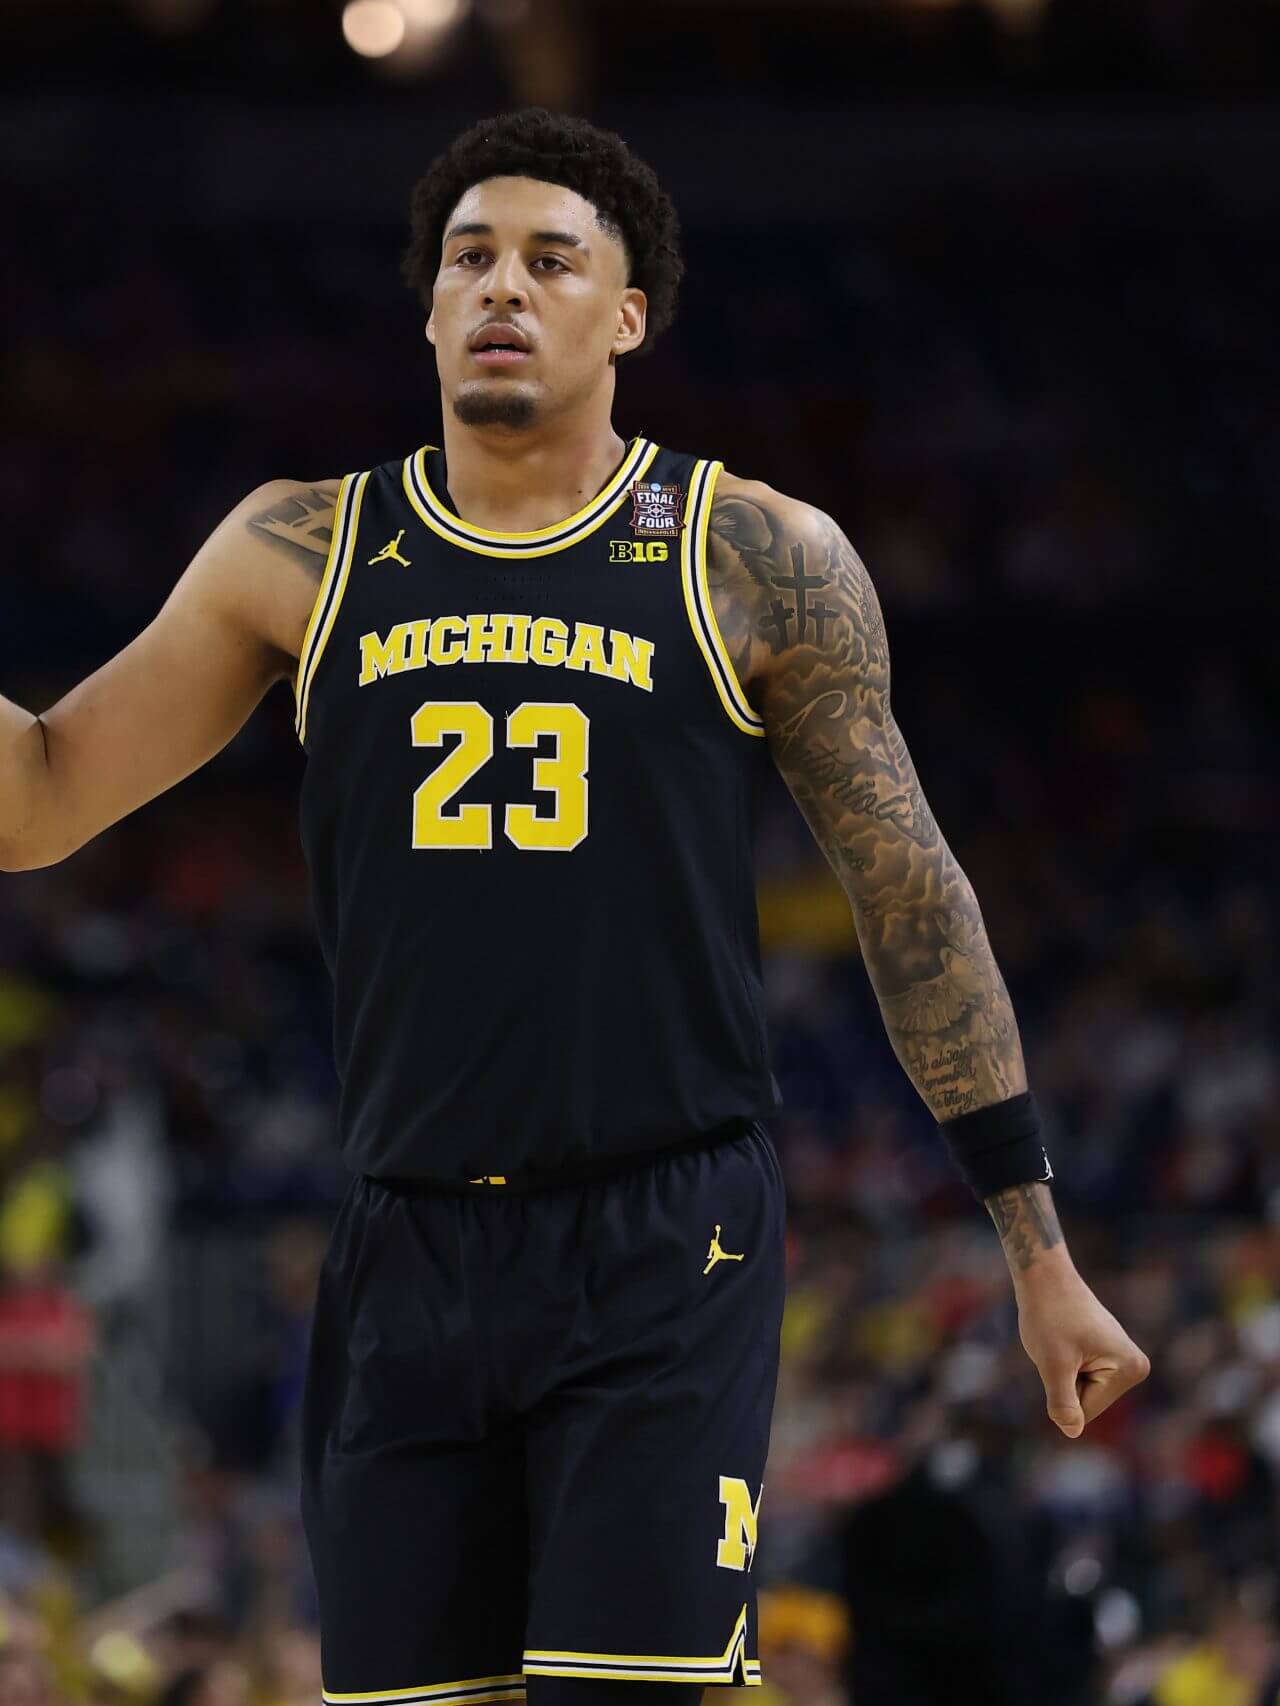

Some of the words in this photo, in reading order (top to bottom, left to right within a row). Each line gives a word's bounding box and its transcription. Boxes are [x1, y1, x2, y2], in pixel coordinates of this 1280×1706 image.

[636, 492, 675, 505] FINAL
[637, 516, 676, 529] FOUR
[359, 614, 655, 692] MICHIGAN
[410, 701, 591, 853] 23
